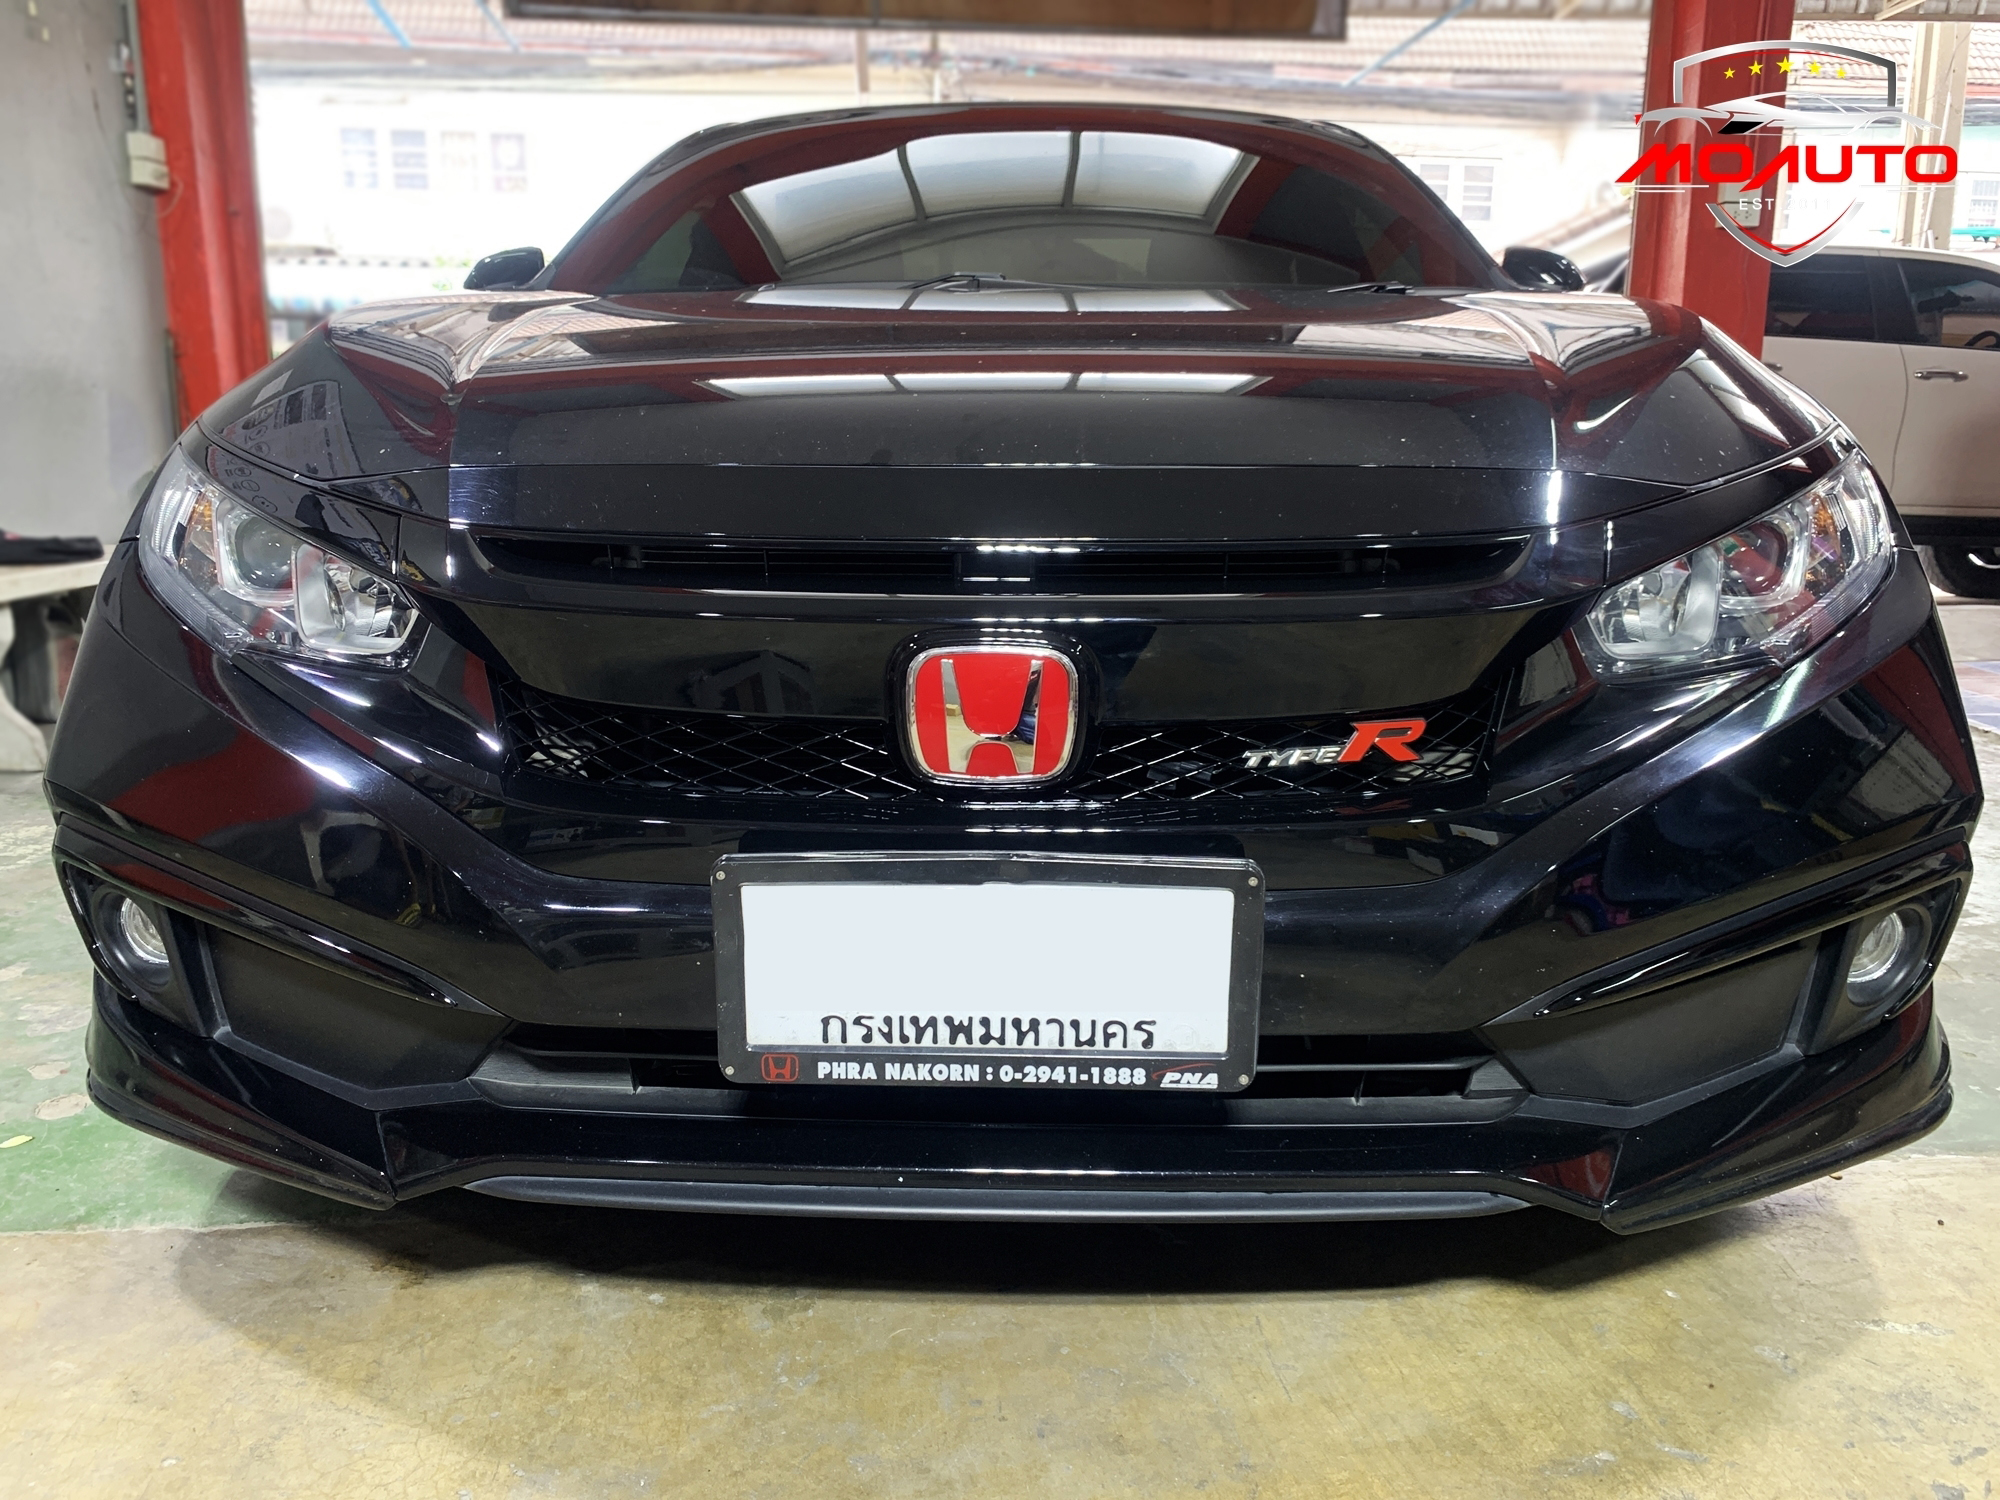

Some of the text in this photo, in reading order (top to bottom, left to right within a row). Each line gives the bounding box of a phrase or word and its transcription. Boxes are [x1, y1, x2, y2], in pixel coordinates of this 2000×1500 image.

[1242, 717, 1427, 769] TYPE R
[820, 1014, 1157, 1050] กรงเทพมหานคร
[817, 1061, 878, 1080] PHRA
[884, 1062, 980, 1082] NAKORN
[998, 1064, 1147, 1086] 0-2941-1888
[1160, 1071, 1219, 1086] PNA
